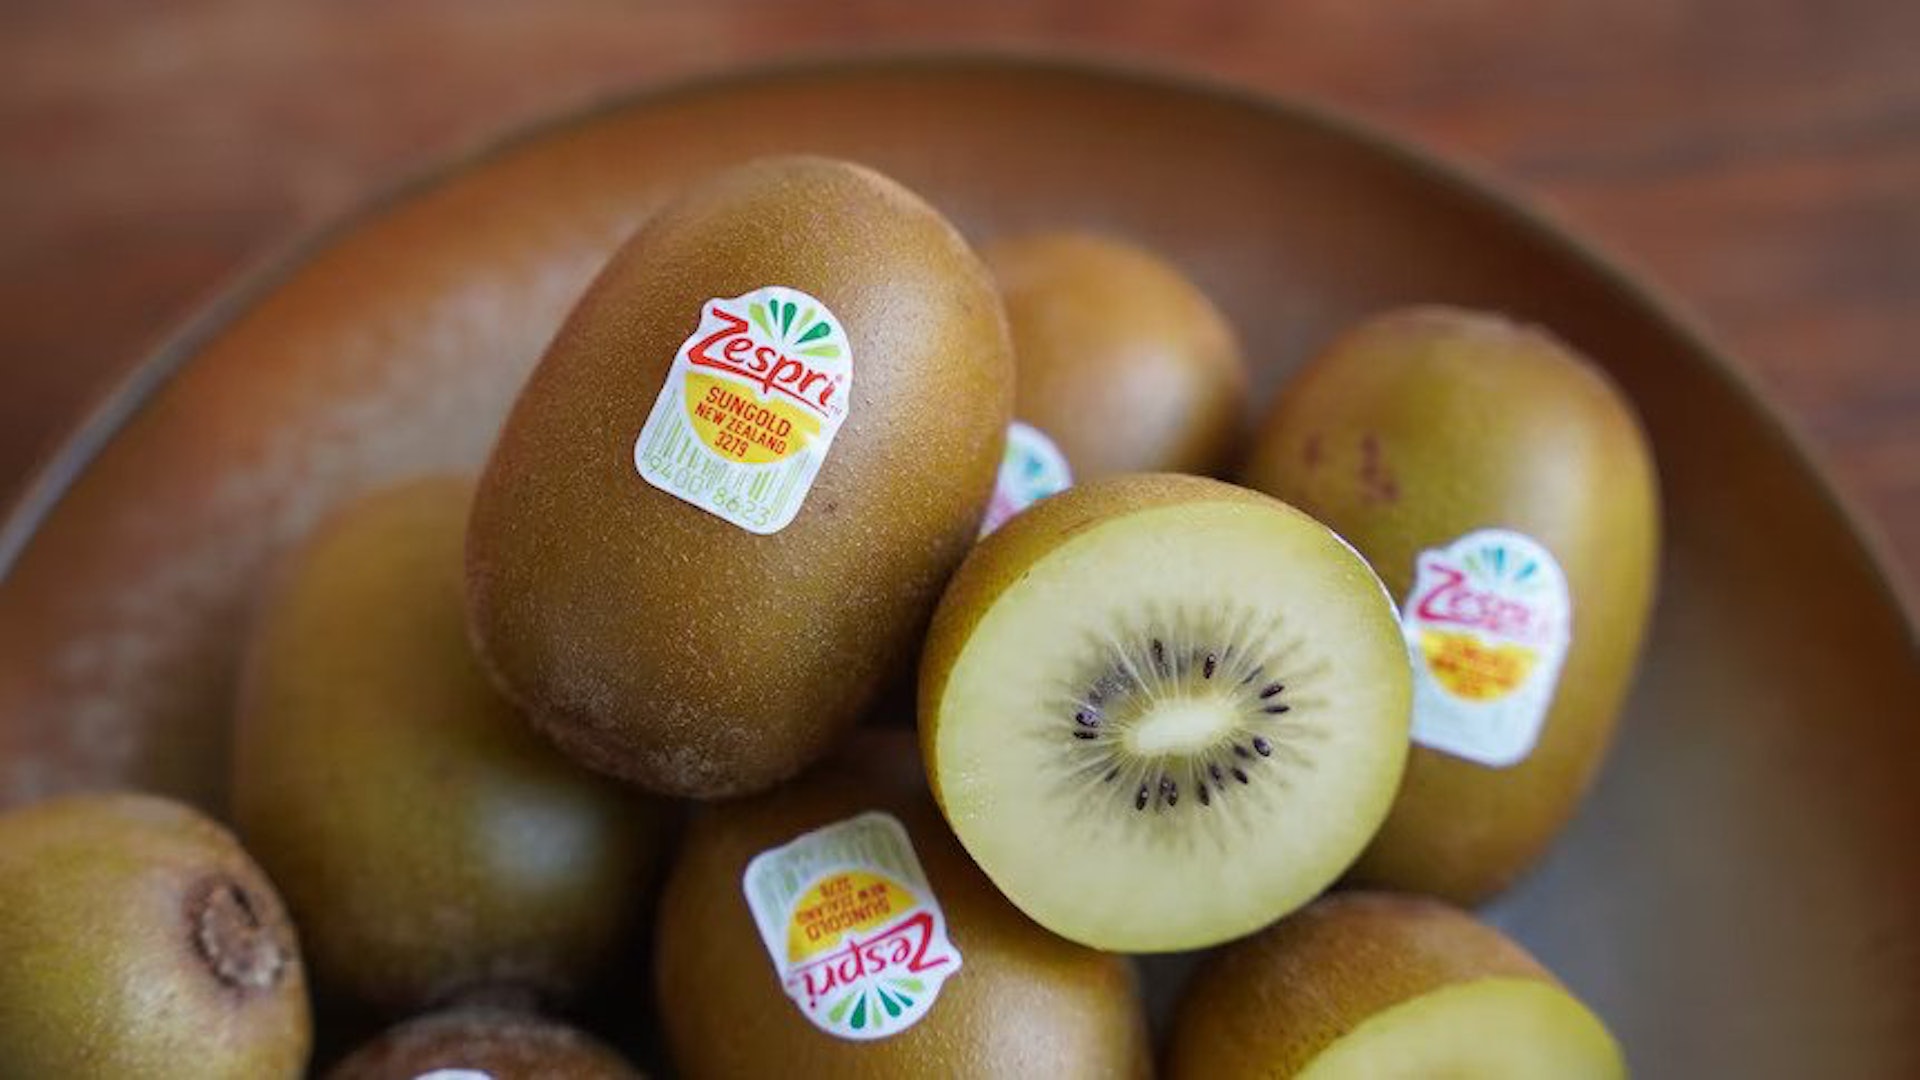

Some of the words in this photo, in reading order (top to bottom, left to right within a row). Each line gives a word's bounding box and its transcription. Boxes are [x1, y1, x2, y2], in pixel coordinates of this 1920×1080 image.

[688, 307, 836, 415] Zespri
[695, 402, 726, 427] NEW
[726, 418, 787, 455] ZEALAND
[705, 386, 791, 437] SUNGOLD
[714, 430, 749, 458] 3279
[805, 896, 891, 941] SUNGOLD
[795, 911, 949, 1009] Zespri
